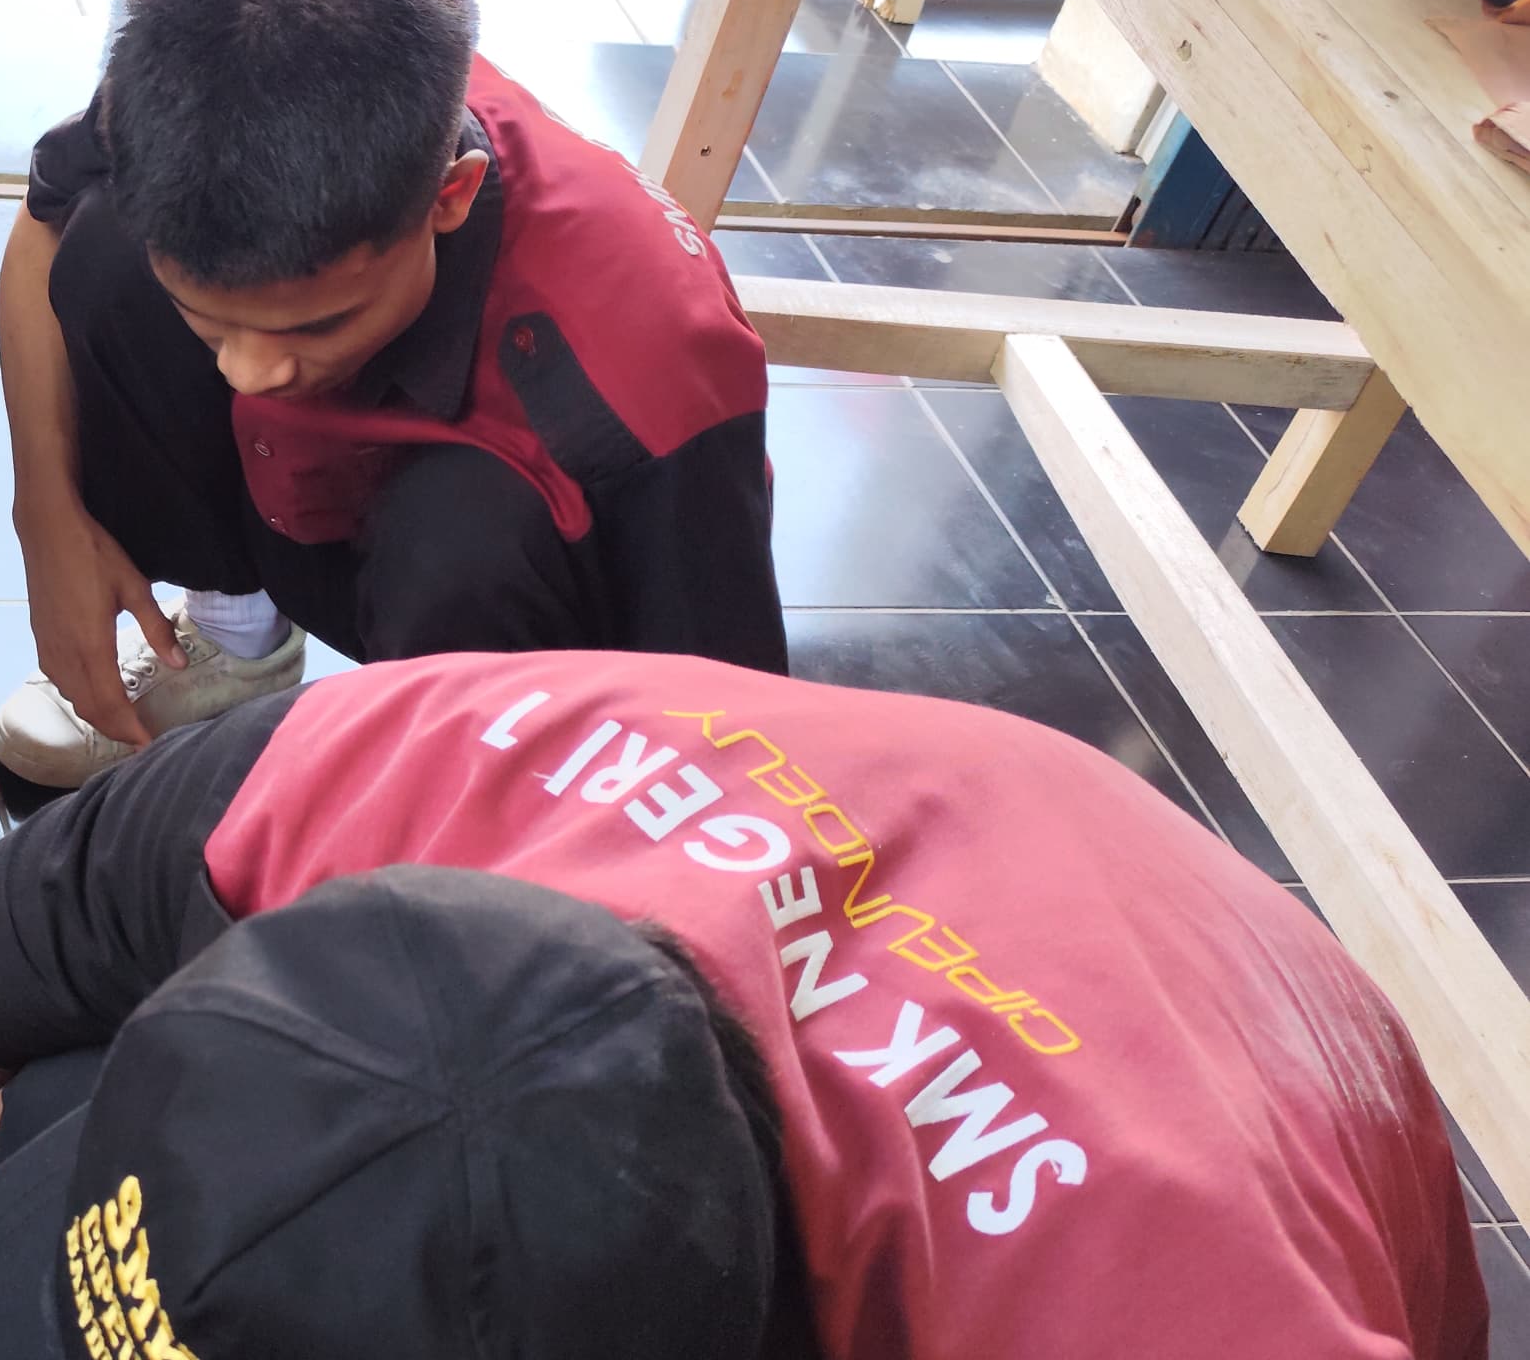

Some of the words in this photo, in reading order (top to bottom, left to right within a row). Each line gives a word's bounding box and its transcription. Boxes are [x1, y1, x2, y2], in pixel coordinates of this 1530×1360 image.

[480, 690, 551, 750] 1
[542, 719, 868, 1021] NEGERI
[662, 708, 1081, 1056] CIPEUNDEUY
[833, 1000, 1088, 1235] SMK
